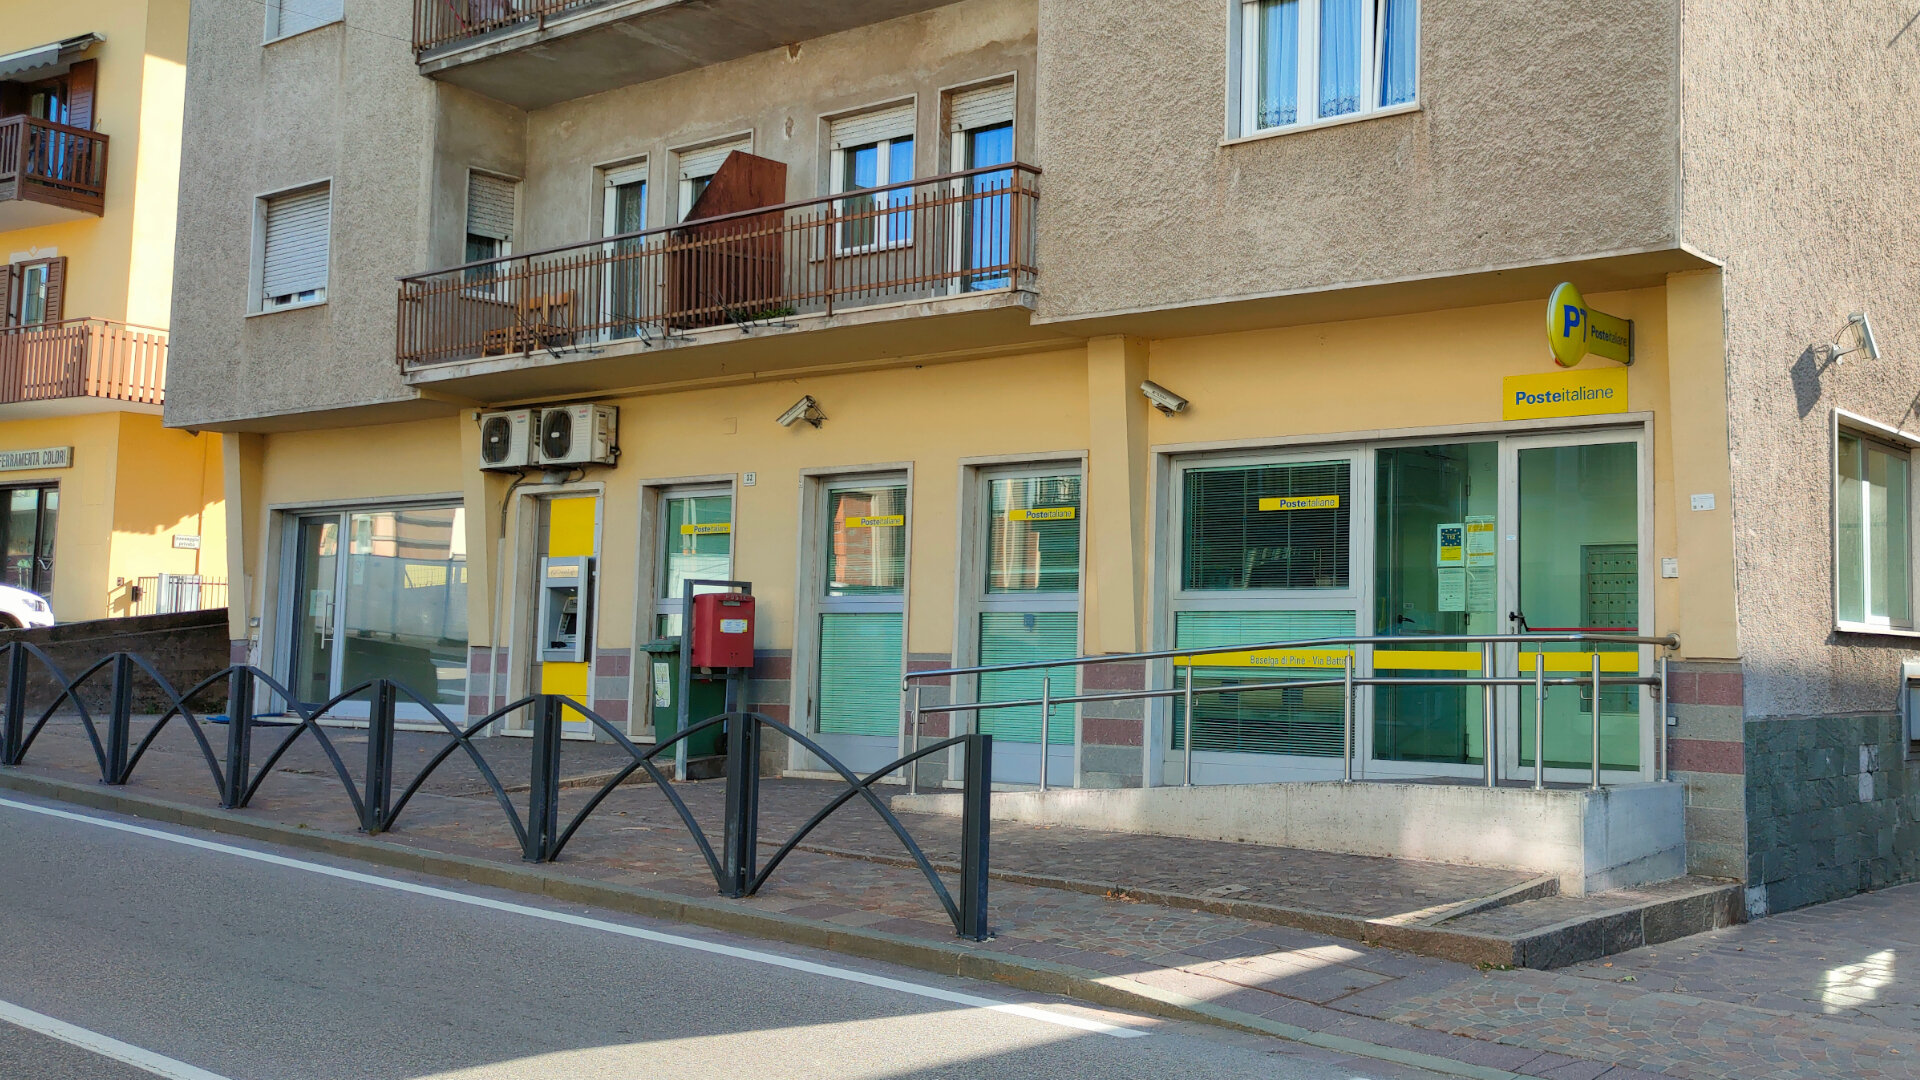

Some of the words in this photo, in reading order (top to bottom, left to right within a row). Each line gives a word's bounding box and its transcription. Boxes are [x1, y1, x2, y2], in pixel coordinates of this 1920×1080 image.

[1515, 386, 1614, 406] Posteitaliane
[43, 449, 66, 465] COLORI
[1250, 655, 1279, 666] Baselga
[1281, 655, 1288, 665] di
[1312, 656, 1324, 665] Via
